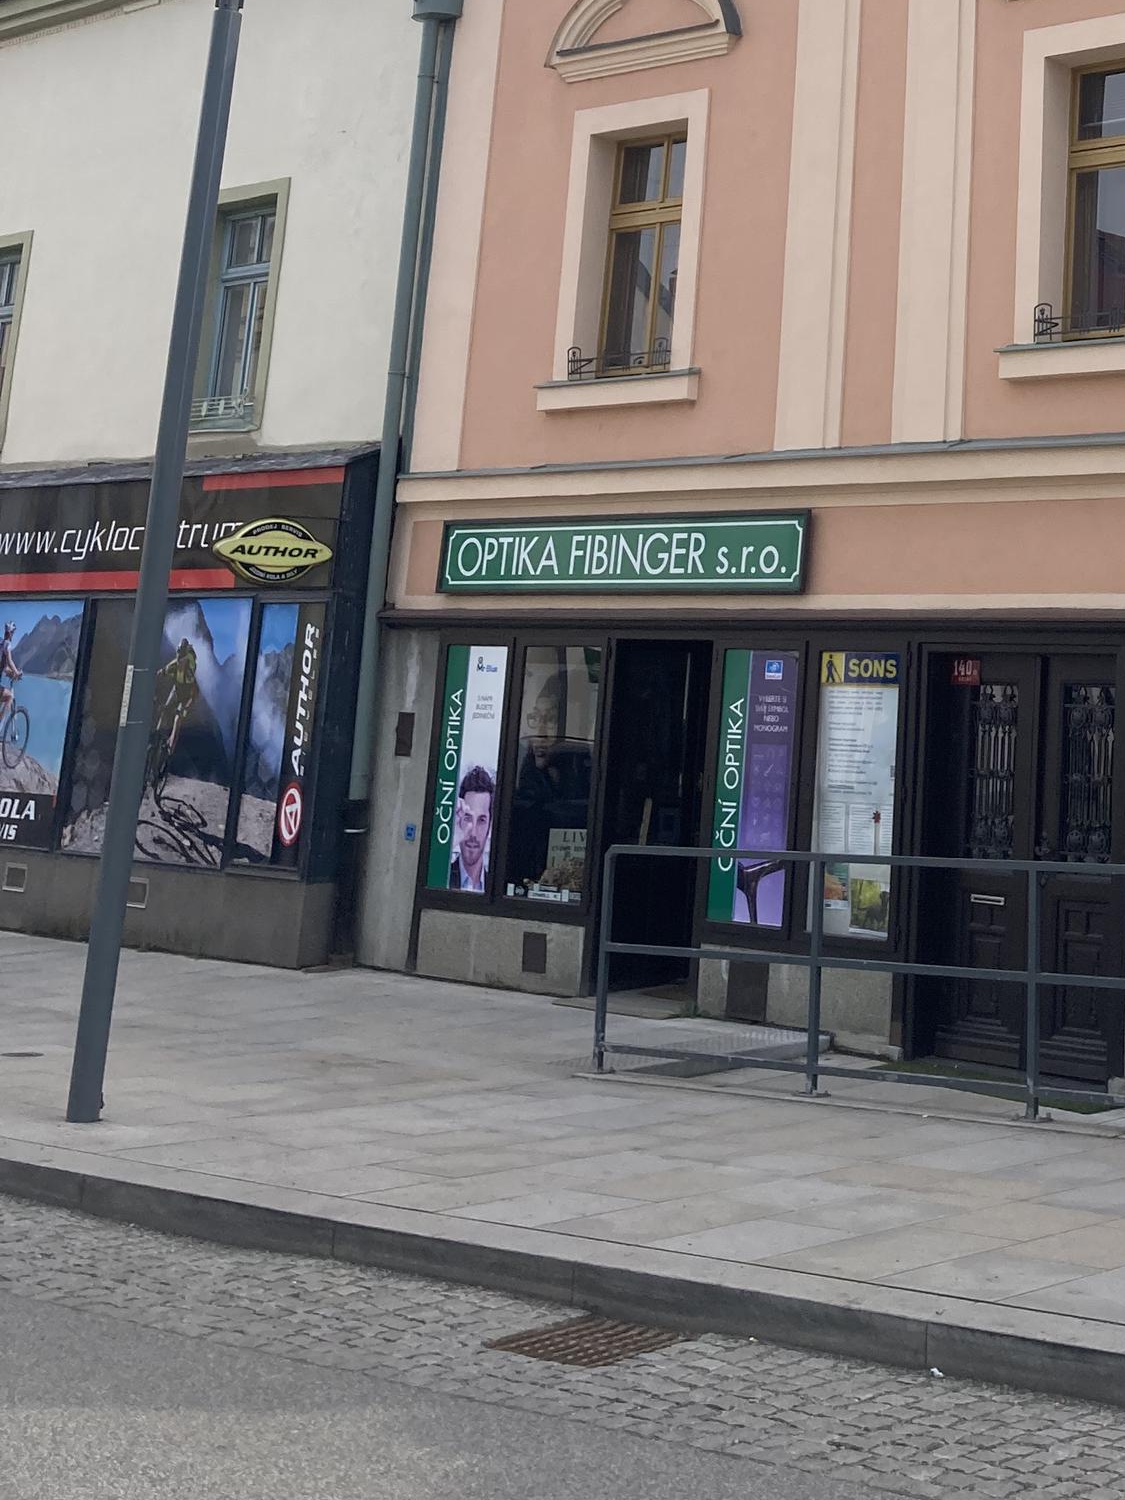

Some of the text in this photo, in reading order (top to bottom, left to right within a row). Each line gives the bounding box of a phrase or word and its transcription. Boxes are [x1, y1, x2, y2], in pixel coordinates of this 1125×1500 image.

[229, 544, 319, 559] AUTHOR
[458, 532, 787, 576] OPTIKA FIBINGER s.r.o.
[291, 623, 316, 777] AUTHOR
[847, 658, 897, 678] SONS
[436, 688, 464, 844] OČNÍ OPTIKA
[724, 698, 745, 790] OPTIKA
